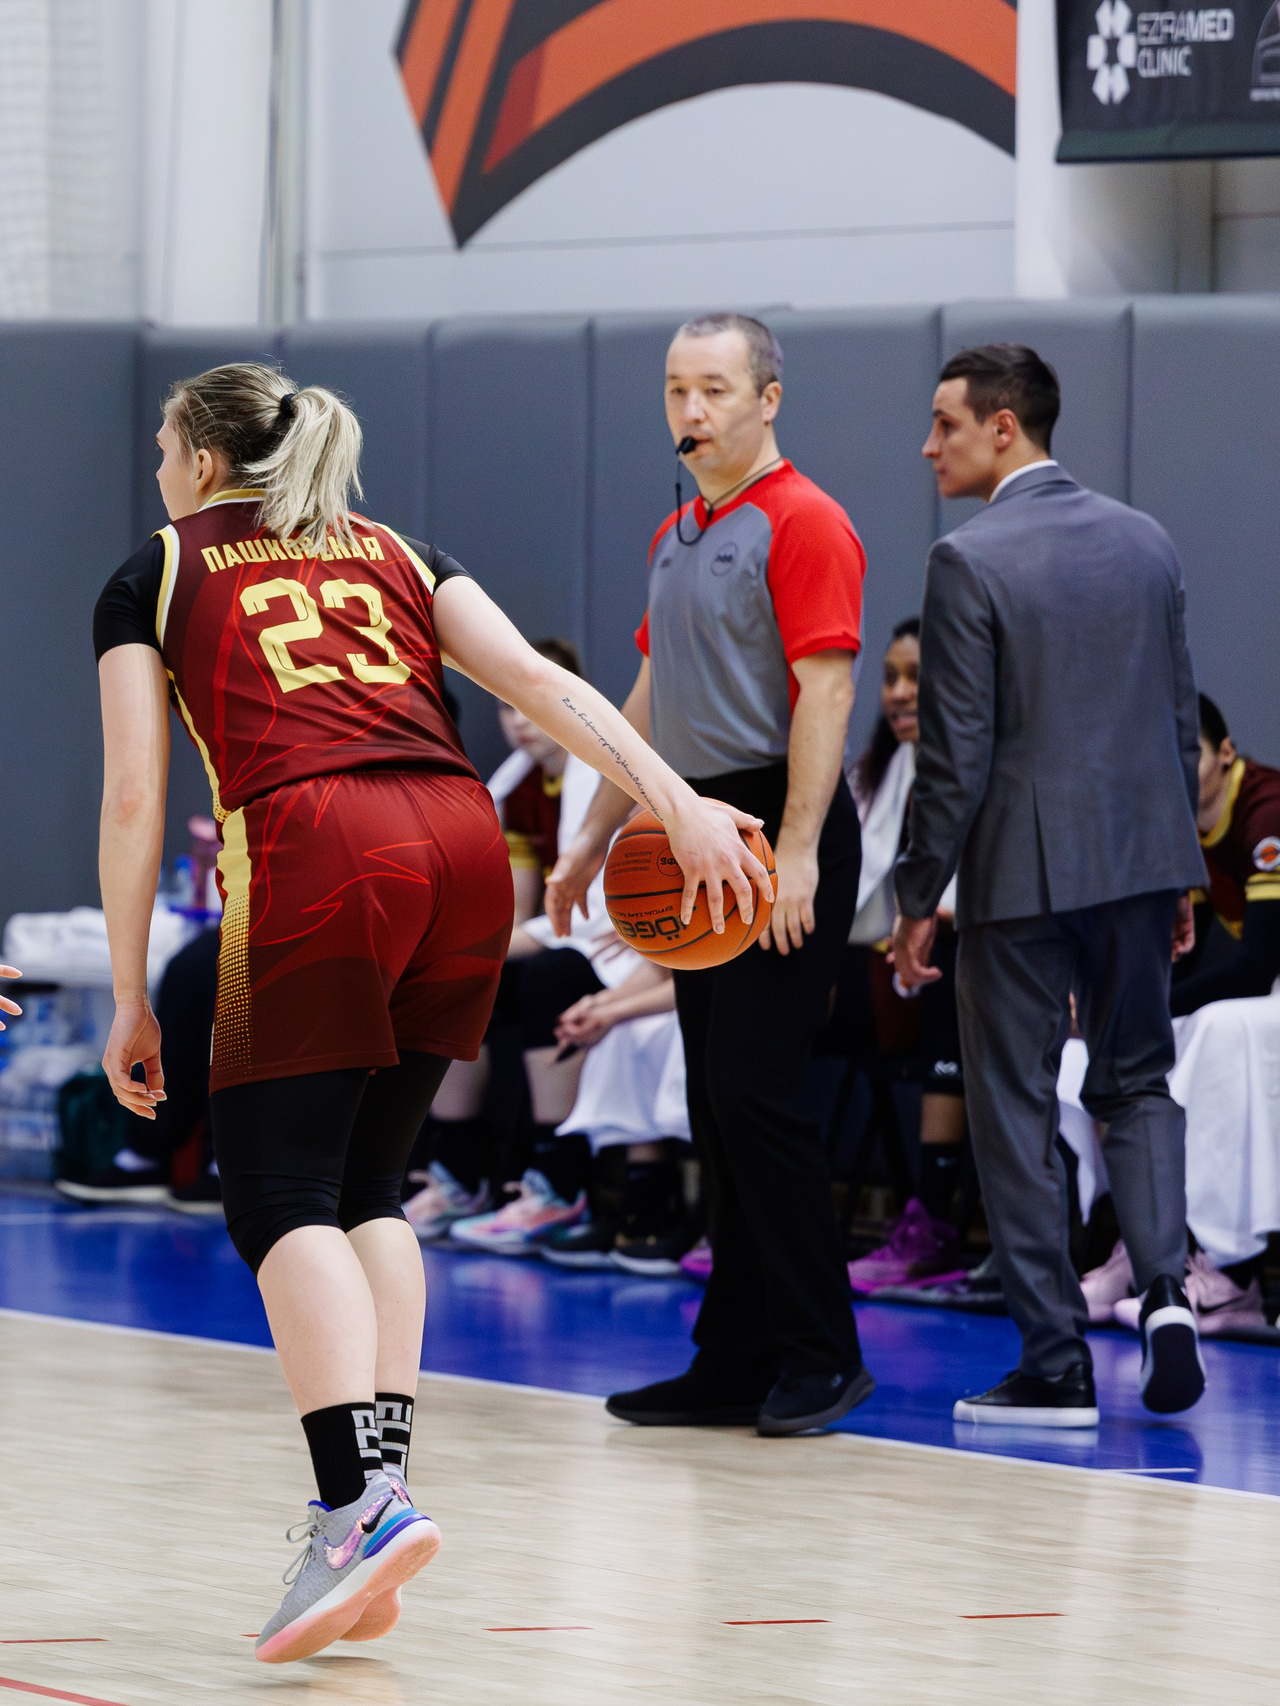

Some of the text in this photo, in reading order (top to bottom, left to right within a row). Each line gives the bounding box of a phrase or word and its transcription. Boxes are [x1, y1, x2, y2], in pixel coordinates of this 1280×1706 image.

[1137, 8, 1235, 45] EZRAMED
[1137, 46, 1193, 78] CLINIC
[200, 536, 385, 574] ПАШКОСКАЯ
[239, 577, 412, 694] 23
